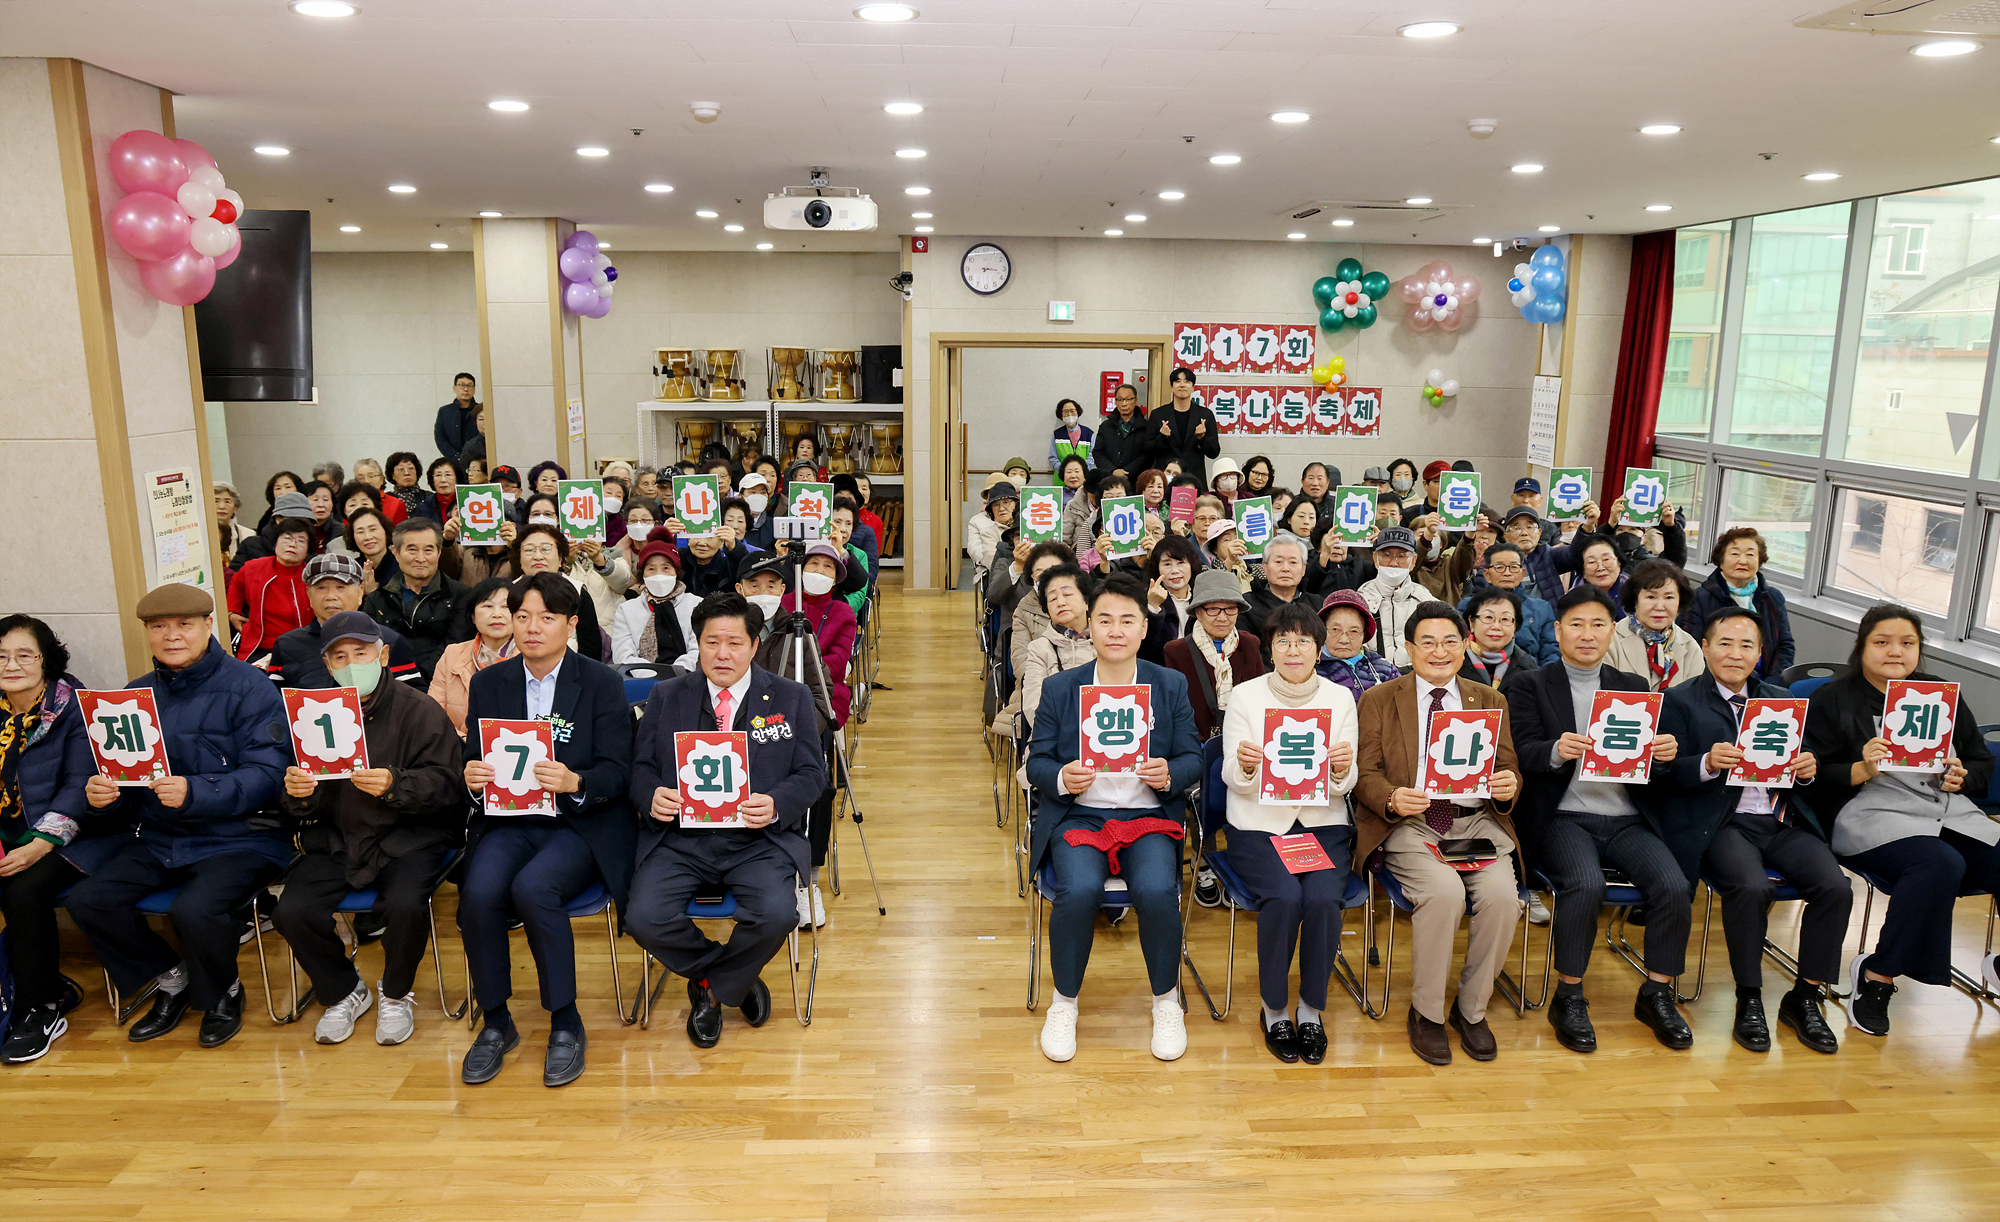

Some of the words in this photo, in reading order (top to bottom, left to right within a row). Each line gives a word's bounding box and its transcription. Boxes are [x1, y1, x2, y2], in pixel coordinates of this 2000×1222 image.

[1191, 397, 1374, 420] 복나눔축제
[497, 465, 510, 474] NY
[685, 491, 711, 515] 나
[1448, 487, 1473, 510] 운
[1558, 483, 1582, 505] 우
[1633, 484, 1658, 508] 리
[469, 501, 494, 524] 언
[569, 496, 594, 520] 제
[1030, 502, 1054, 526] 춘
[1345, 502, 1369, 525] 다
[1113, 511, 1137, 536] 아
[1245, 512, 1267, 538] 를
[1384, 530, 1410, 542] NYPD
[314, 713, 336, 748] 1
[766, 713, 785, 725] 의장
[1092, 706, 1136, 746] 행
[1896, 703, 1941, 740] 제
[97, 713, 146, 752] 제
[752, 722, 793, 743] 안병건
[1601, 713, 1642, 750] 눔
[1751, 720, 1789, 756] 축
[1277, 730, 1317, 770] 복
[1443, 731, 1484, 767] 나
[505, 745, 530, 781] 7
[692, 754, 733, 793] 회
